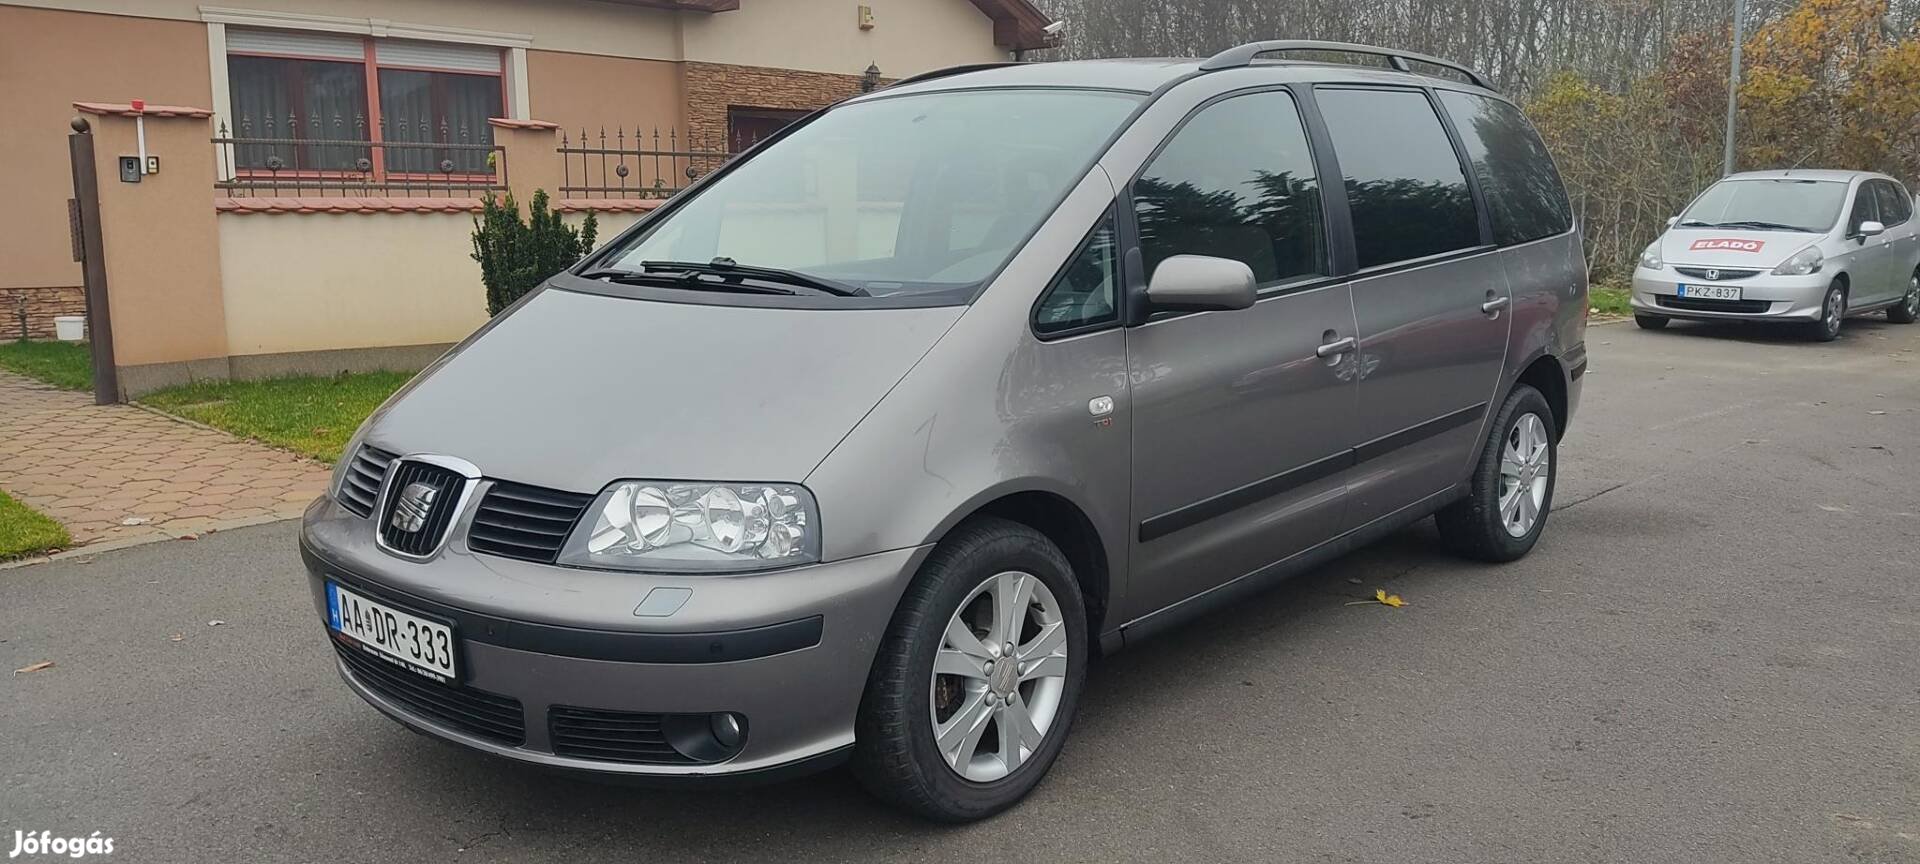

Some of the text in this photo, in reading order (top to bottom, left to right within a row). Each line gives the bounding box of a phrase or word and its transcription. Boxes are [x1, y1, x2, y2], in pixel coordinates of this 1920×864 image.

[1694, 241, 1758, 250] ELADÓ
[1686, 286, 1738, 299] PKZ-837
[332, 608, 338, 619] H
